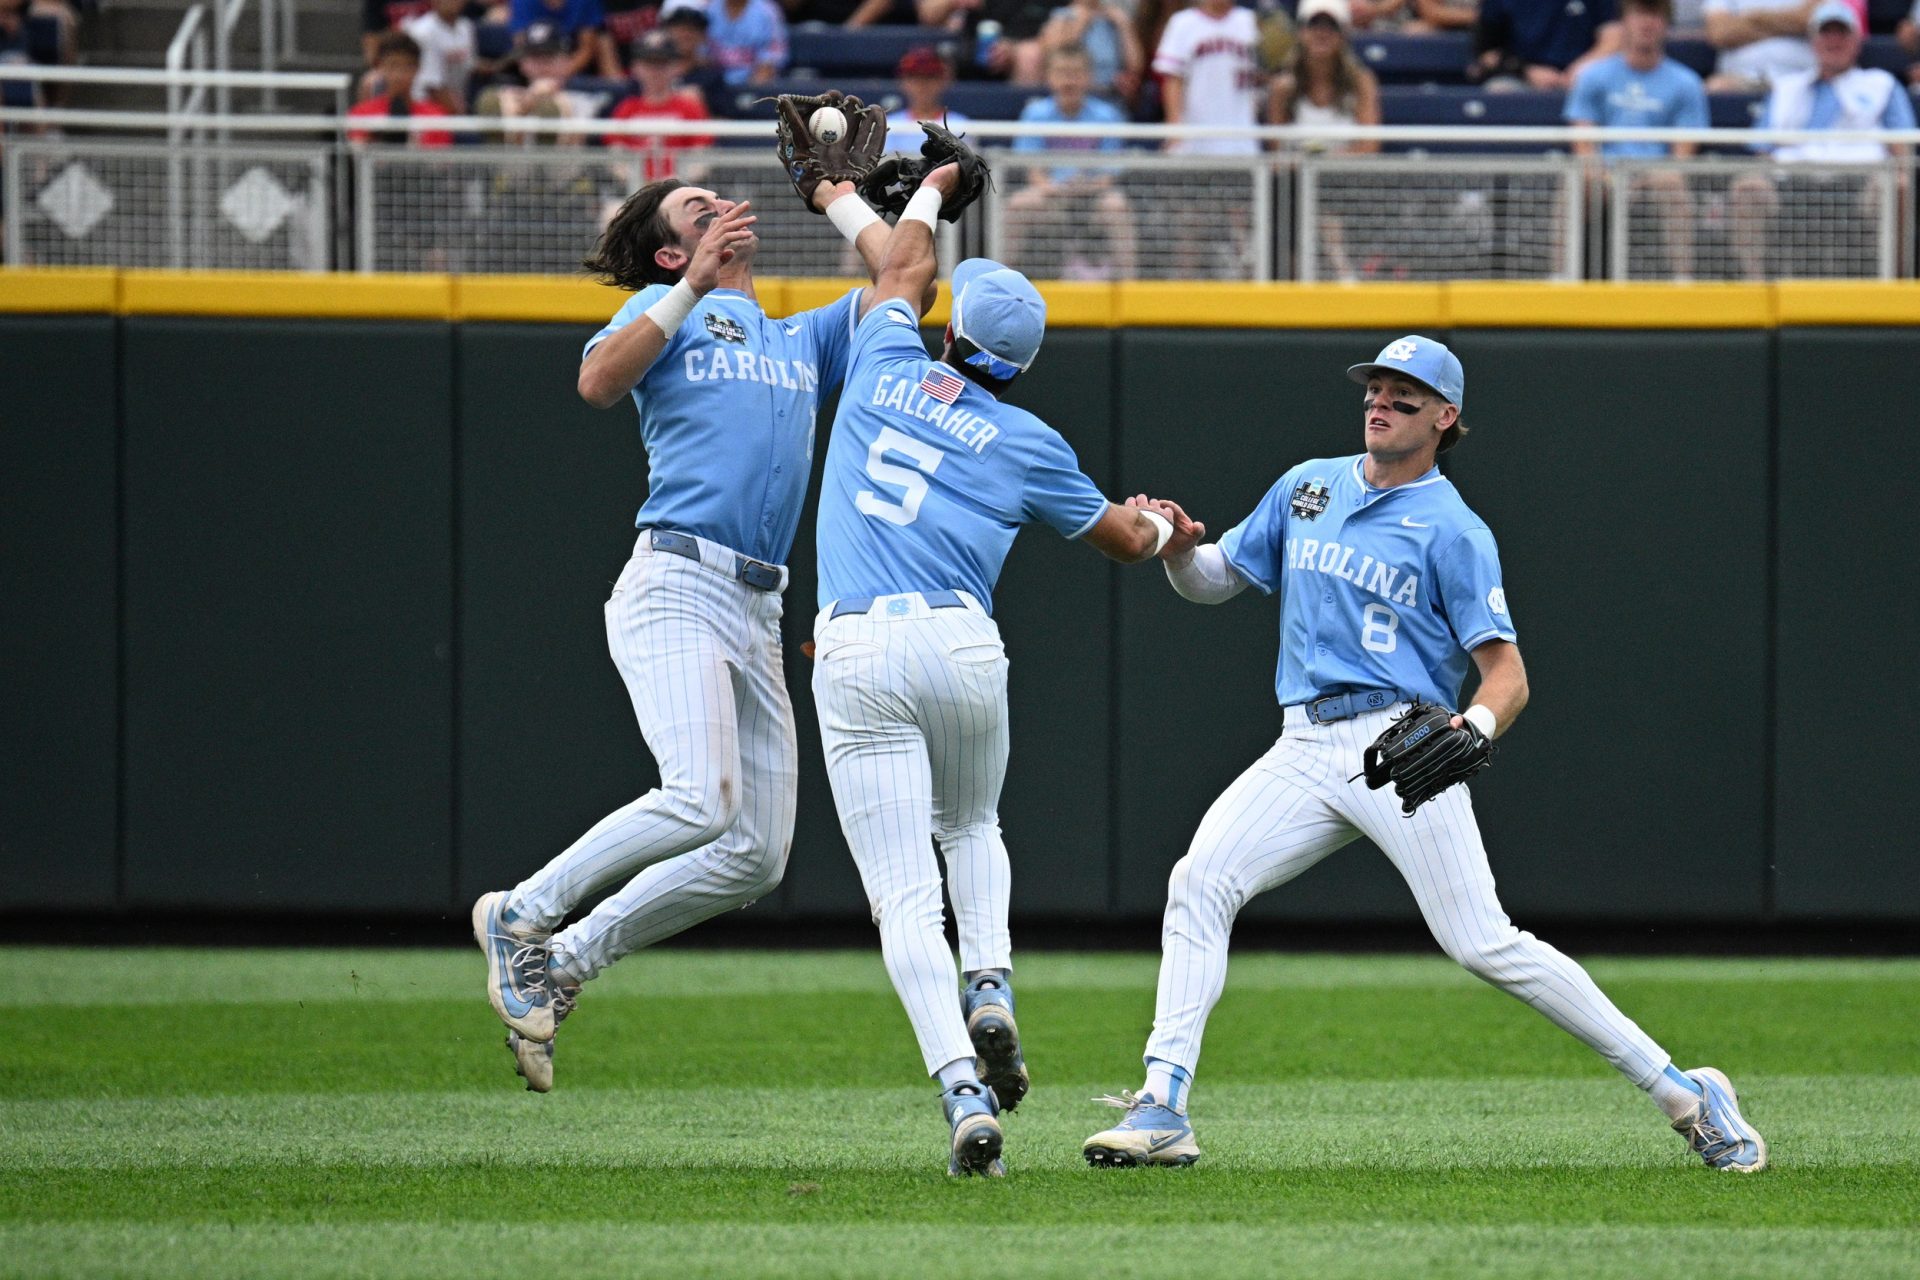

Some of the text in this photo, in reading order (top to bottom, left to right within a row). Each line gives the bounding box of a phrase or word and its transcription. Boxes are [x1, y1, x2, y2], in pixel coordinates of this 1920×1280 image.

[872, 375, 1000, 454] GALLAHER
[855, 425, 945, 527] 5
[1286, 538, 1418, 608] AROLINA
[1361, 602, 1399, 653] 8
[1404, 725, 1430, 748] A2000
